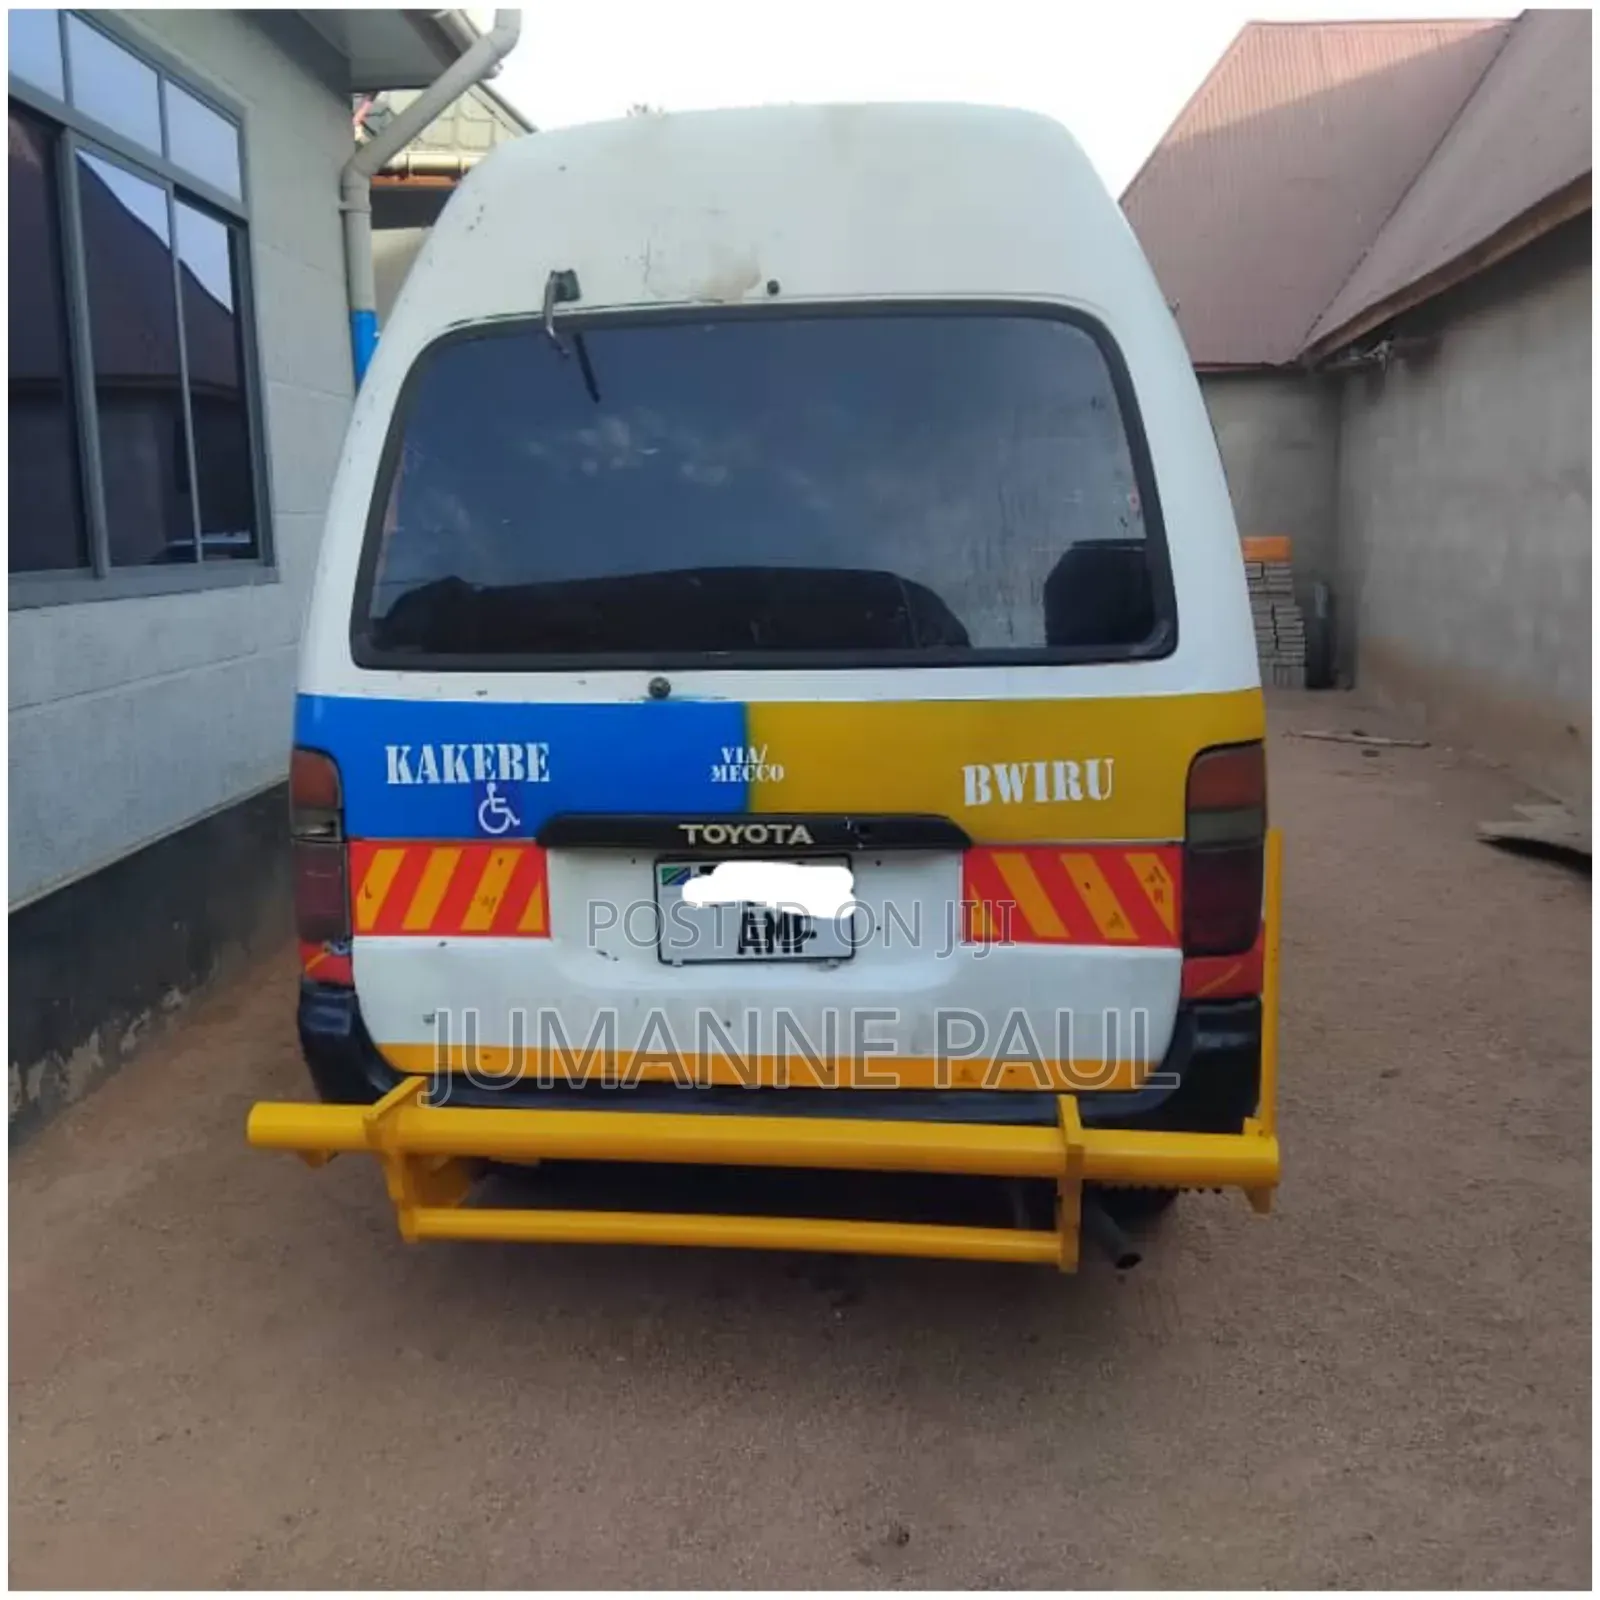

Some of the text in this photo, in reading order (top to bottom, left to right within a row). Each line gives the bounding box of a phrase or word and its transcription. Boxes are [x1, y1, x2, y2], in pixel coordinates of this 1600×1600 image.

[386, 743, 550, 784] KAKEBE
[709, 763, 785, 783] MECCO
[962, 759, 1114, 807] BWIRU
[679, 823, 814, 845] TOYOTA
